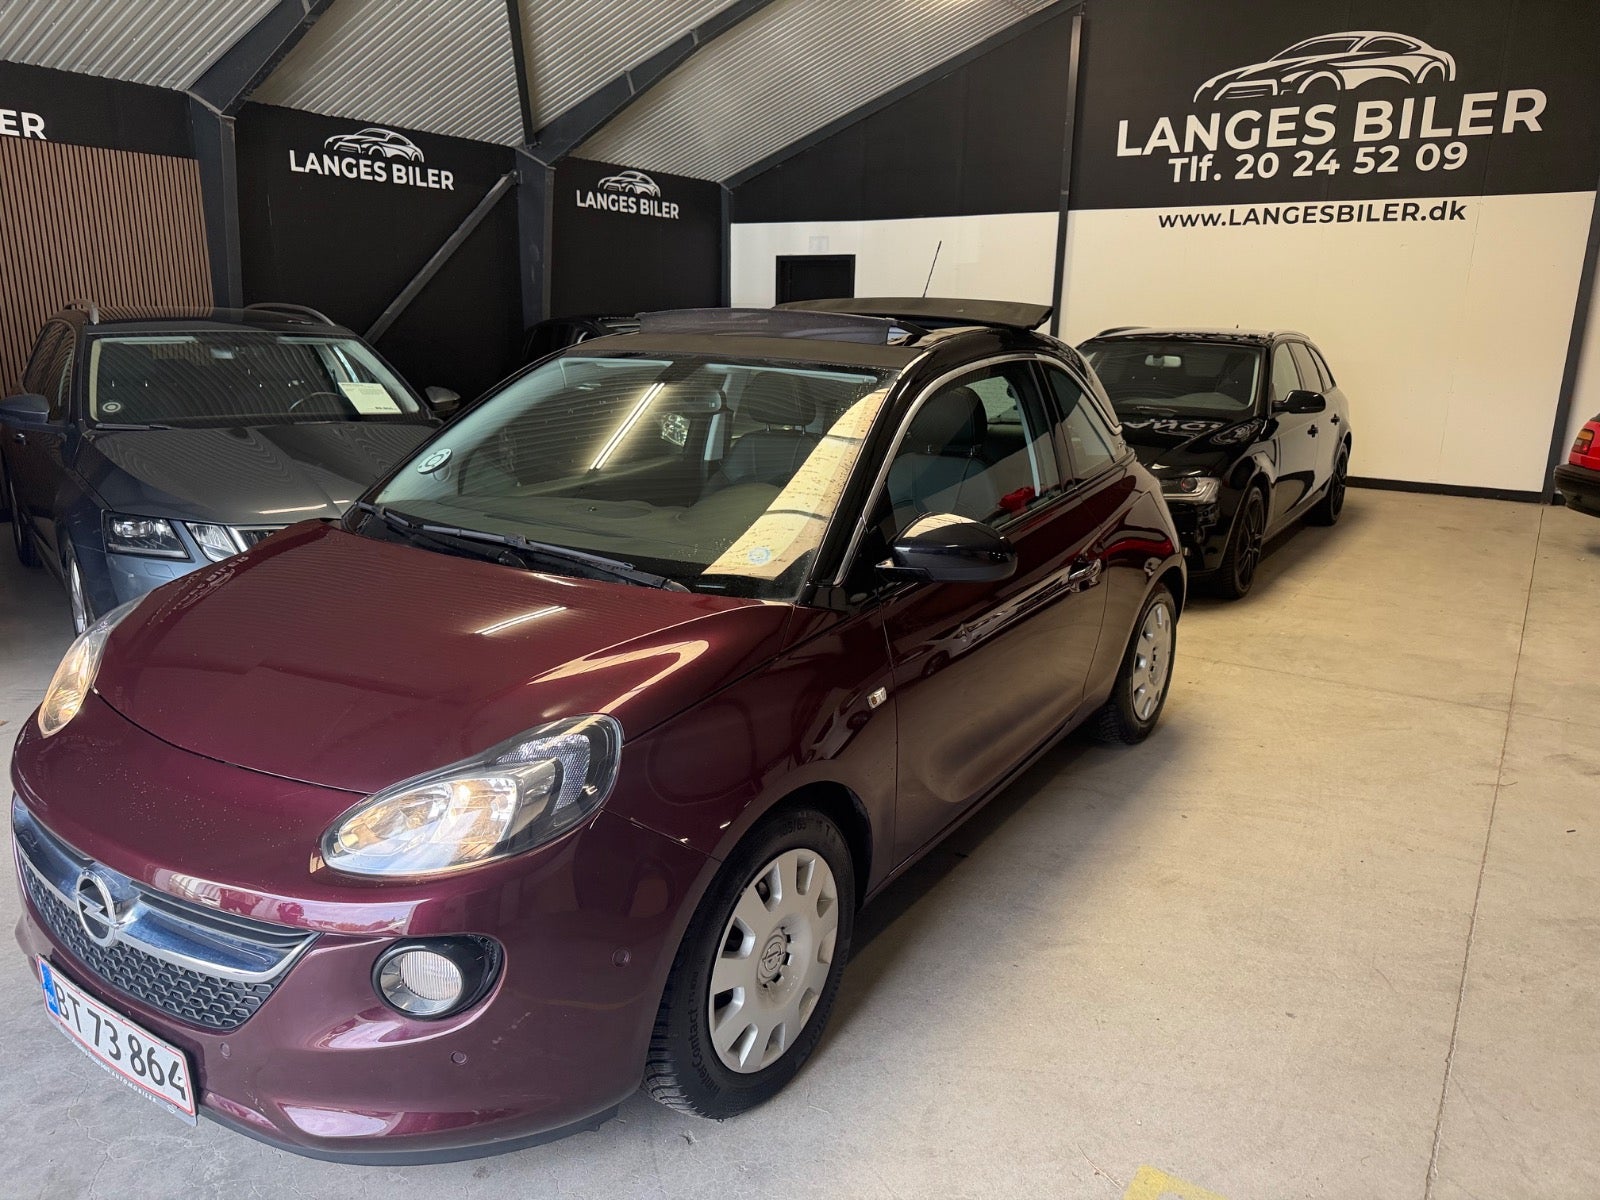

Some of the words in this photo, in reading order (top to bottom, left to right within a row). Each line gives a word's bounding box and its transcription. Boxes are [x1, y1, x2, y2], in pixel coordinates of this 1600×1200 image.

[1116, 104, 1337, 157] LANGES
[1353, 88, 1547, 142] BILER
[289, 150, 387, 182] LANGES
[392, 164, 454, 190] BILER
[1168, 153, 1222, 183] Tlf.
[1235, 151, 1280, 180] 20
[1293, 148, 1340, 177] 24
[1353, 145, 1399, 174] 52
[1415, 141, 1468, 171] 09
[576, 189, 637, 214] LANGES
[640, 198, 679, 219] BILER
[1158, 200, 1467, 228] www.LANGESBILER.dk
[54, 981, 81, 1033] BT
[87, 1007, 121, 1061] 73
[127, 1033, 187, 1101] 864
